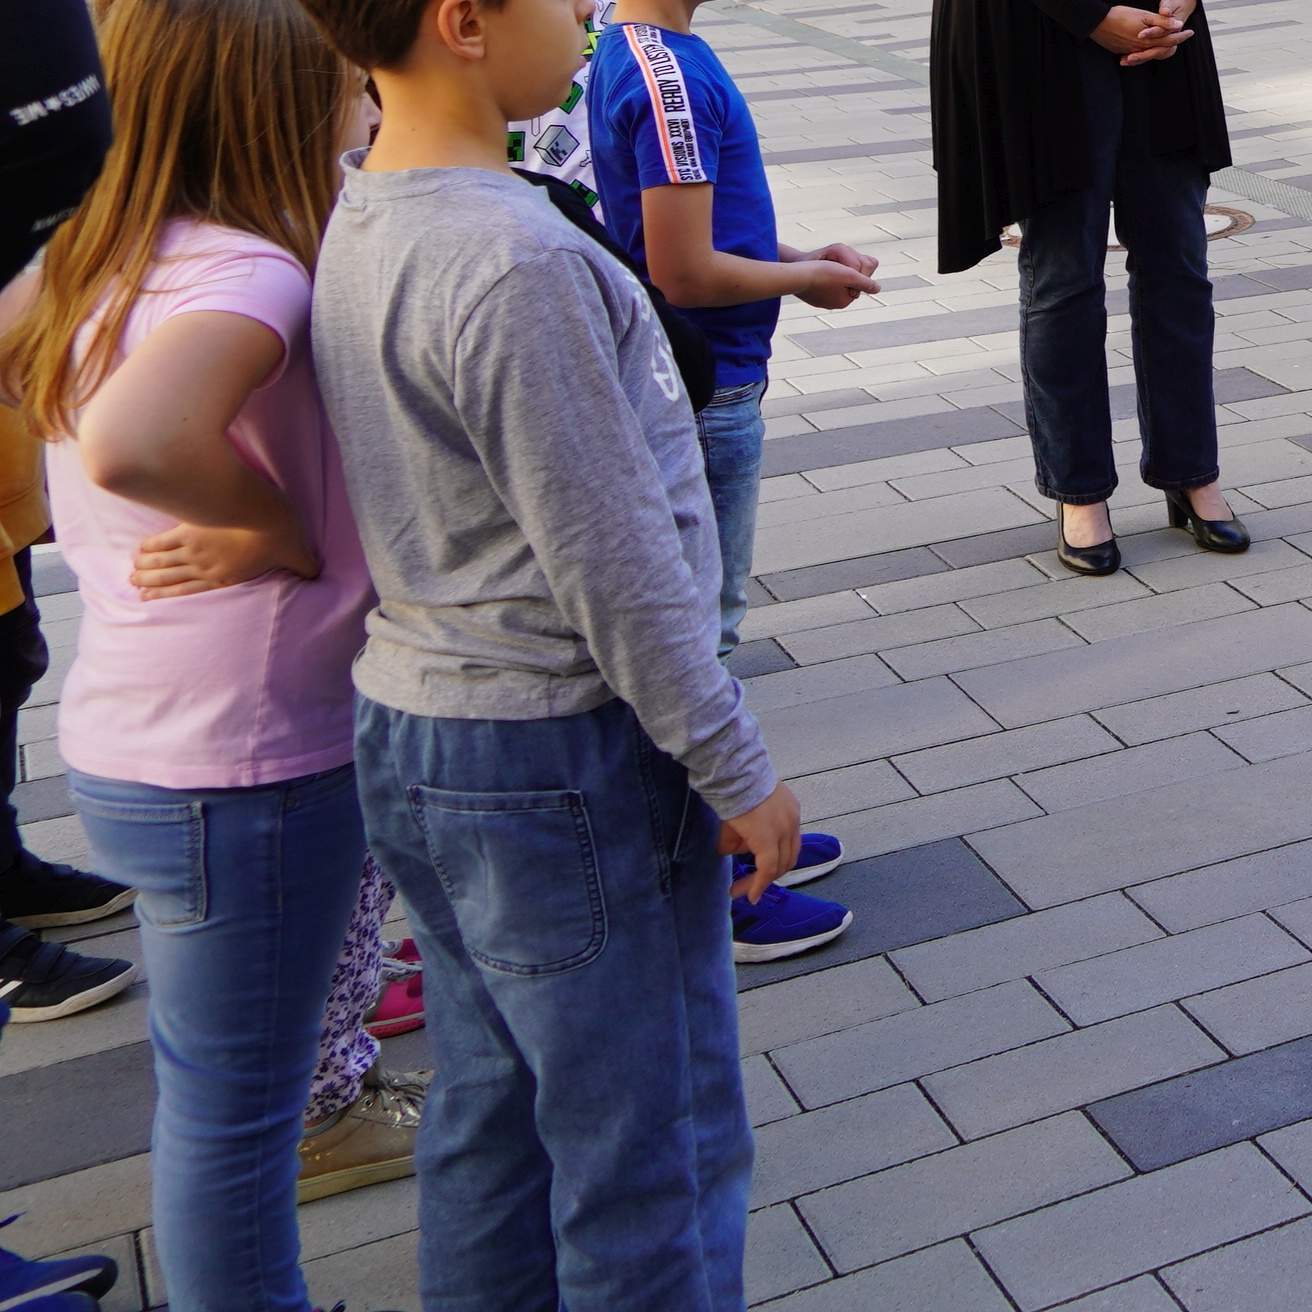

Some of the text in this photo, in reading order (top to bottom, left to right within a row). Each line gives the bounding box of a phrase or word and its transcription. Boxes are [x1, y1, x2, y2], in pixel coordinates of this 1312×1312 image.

[653, 64, 676, 79] TO
[657, 79, 686, 114] READY
[674, 141, 690, 168] VISIONS
